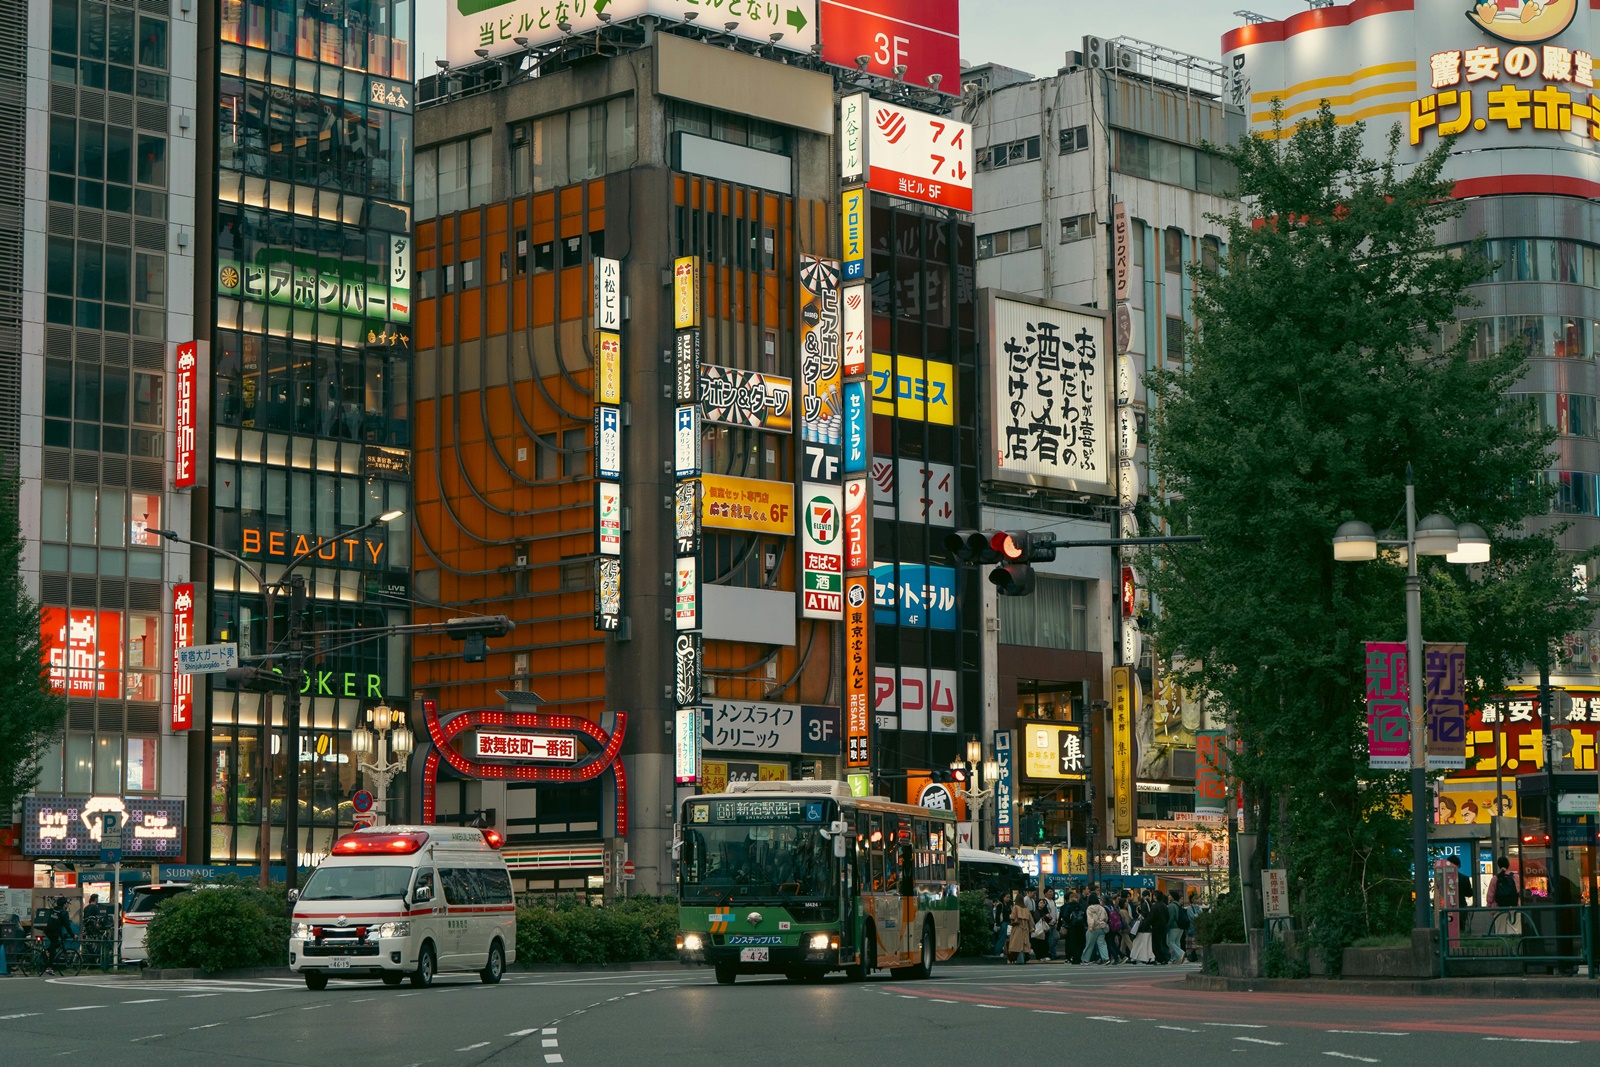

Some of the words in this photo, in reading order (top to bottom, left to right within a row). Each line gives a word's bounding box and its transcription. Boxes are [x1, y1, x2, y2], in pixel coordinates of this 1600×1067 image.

[479, 0, 586, 47] 当ビルとなり
[874, 32, 909, 67] 3F
[1430, 45, 1594, 88] 驚安の殿堂
[845, 103, 859, 169] 戸谷ビル
[898, 178, 925, 195] 当ビル
[928, 184, 942, 199] 5F
[848, 196, 859, 255] プロミス
[394, 239, 407, 283] ダーツ
[848, 263, 861, 275] 6F
[245, 266, 386, 311] ビアポンバー
[604, 263, 615, 324] 小松ビル
[683, 334, 691, 361] BUZZ
[683, 363, 691, 399] STAND
[850, 365, 859, 375] 5F
[872, 369, 949, 406] プロミス
[1004, 336, 1029, 461] だけの店
[1075, 327, 1096, 471] おやじが喜ぶ
[1060, 340, 1079, 467] こだわりの
[181, 371, 194, 479] GAME
[850, 394, 861, 461] セントラル
[805, 446, 838, 480] 7F
[770, 504, 788, 523] 6F
[813, 522, 832, 530] ELEVEN
[242, 528, 384, 564] BEAUTY
[679, 539, 692, 552] 7F
[850, 514, 862, 555] アコム
[808, 553, 838, 572] たばこ
[851, 558, 861, 566] 3F
[815, 574, 830, 590] 酒
[874, 580, 955, 611] セントラル
[808, 594, 839, 610] ATM
[603, 615, 618, 629] 7F
[909, 615, 918, 624] 4F
[181, 647, 234, 663] 新宿大ガード東
[851, 612, 863, 689] 東京ぶらんど
[875, 676, 954, 713] アコム
[717, 704, 794, 726] メンズライフ
[858, 693, 866, 732] LUXURY
[717, 727, 780, 748] クリニック
[808, 719, 833, 741] 3F
[479, 736, 573, 758] 歌舞伎町一番街
[1061, 733, 1085, 771] 集
[854, 777, 863, 797] レイ
[736, 802, 800, 815] 新宿駅西口
[104, 815, 117, 834] P
[451, 832, 482, 843] AMBULANCE
[166, 868, 215, 878] SUBNADE
[729, 936, 782, 944] ノンステップバス
